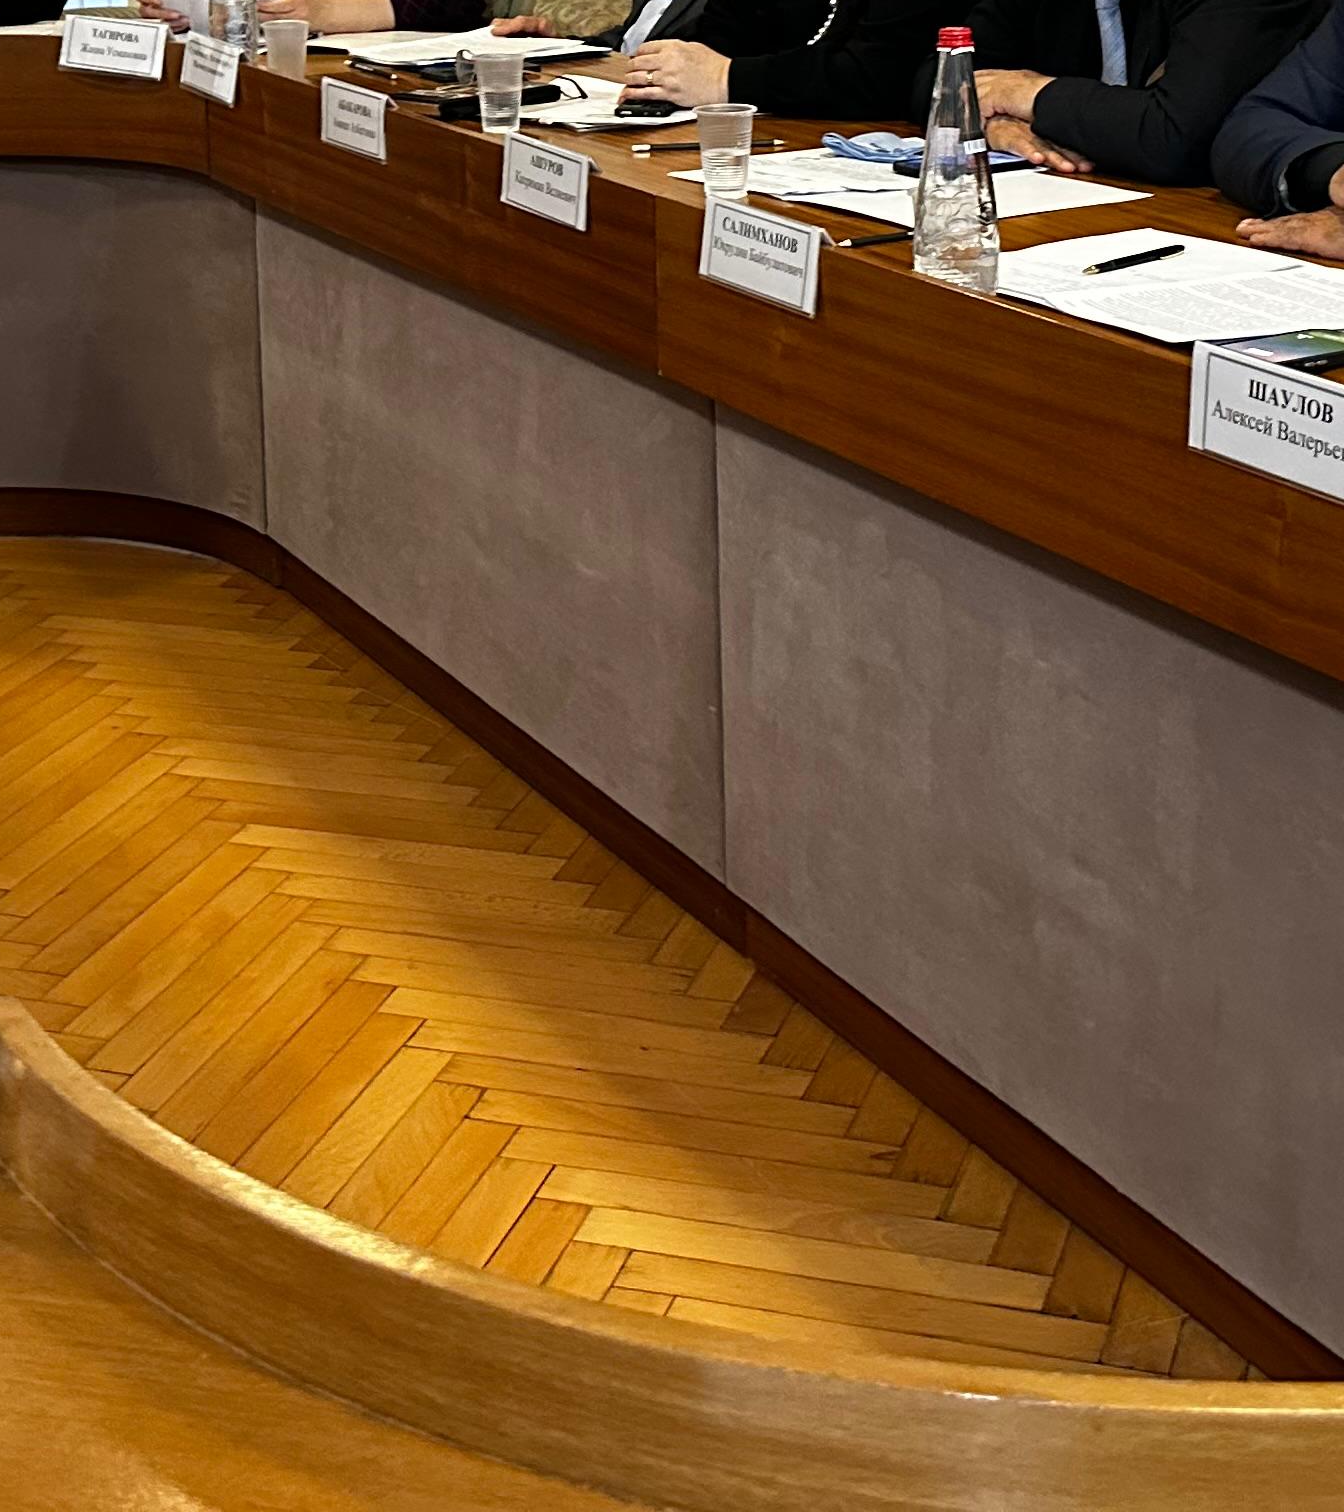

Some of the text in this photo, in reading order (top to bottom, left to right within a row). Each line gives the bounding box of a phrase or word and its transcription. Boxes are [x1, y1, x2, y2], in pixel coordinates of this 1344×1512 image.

[722, 216, 798, 254] САЛИМХАНОВ
[1212, 400, 1273, 437] Алексей
[1248, 378, 1333, 424] ШАУЛОВ
